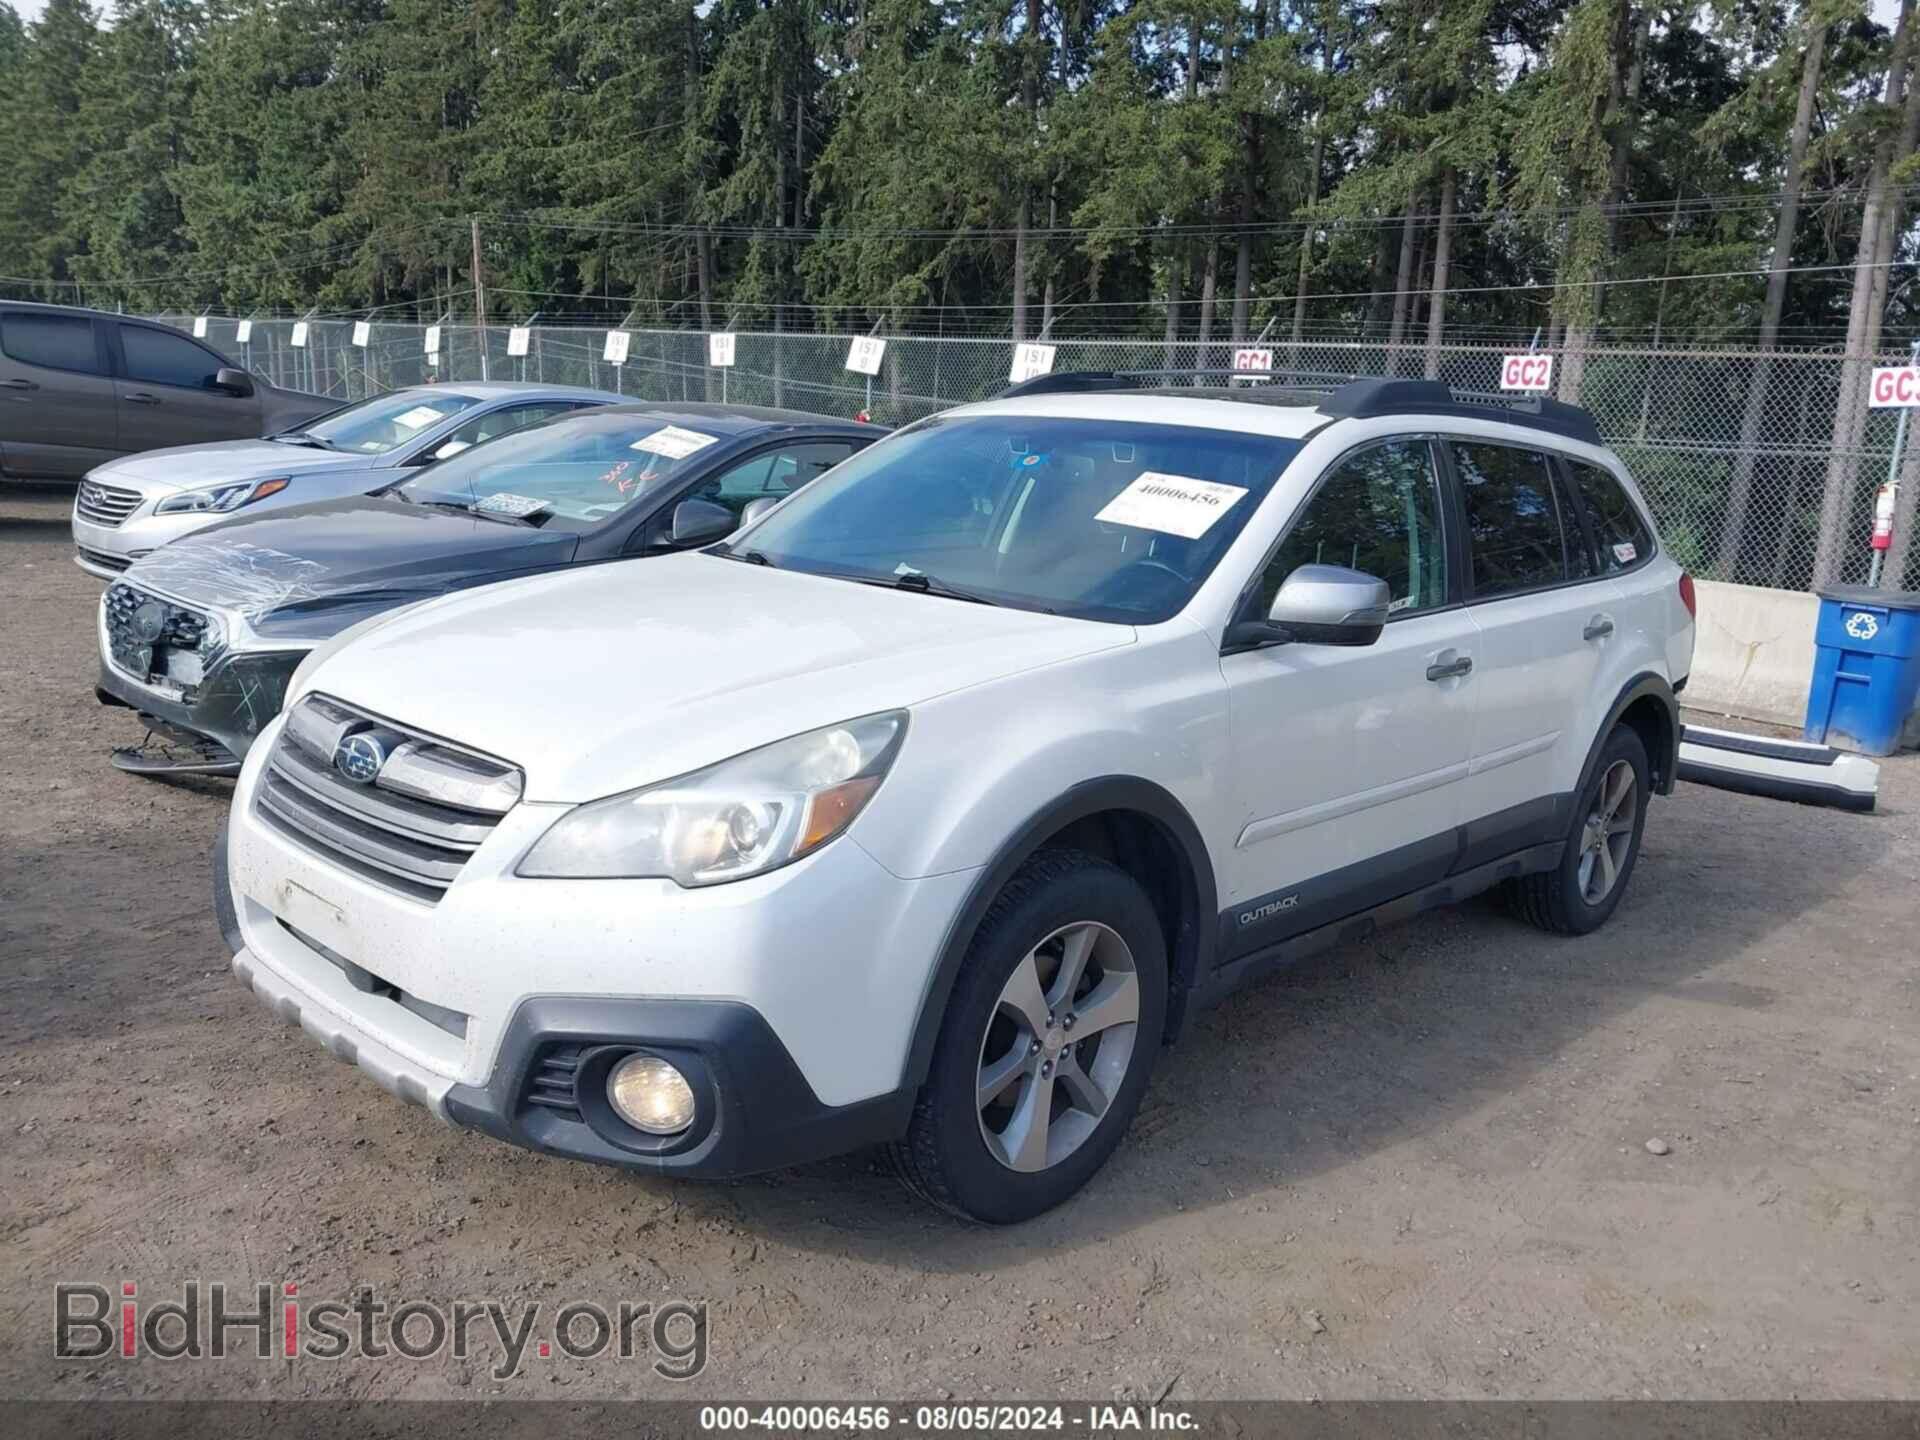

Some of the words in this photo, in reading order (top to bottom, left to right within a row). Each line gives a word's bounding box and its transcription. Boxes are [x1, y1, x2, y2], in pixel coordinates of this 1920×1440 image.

[1236, 352, 1268, 370] GC1
[1506, 359, 1548, 385] GC2
[1138, 483, 1220, 506] 40006456
[1240, 894, 1299, 924] OUTBACK
